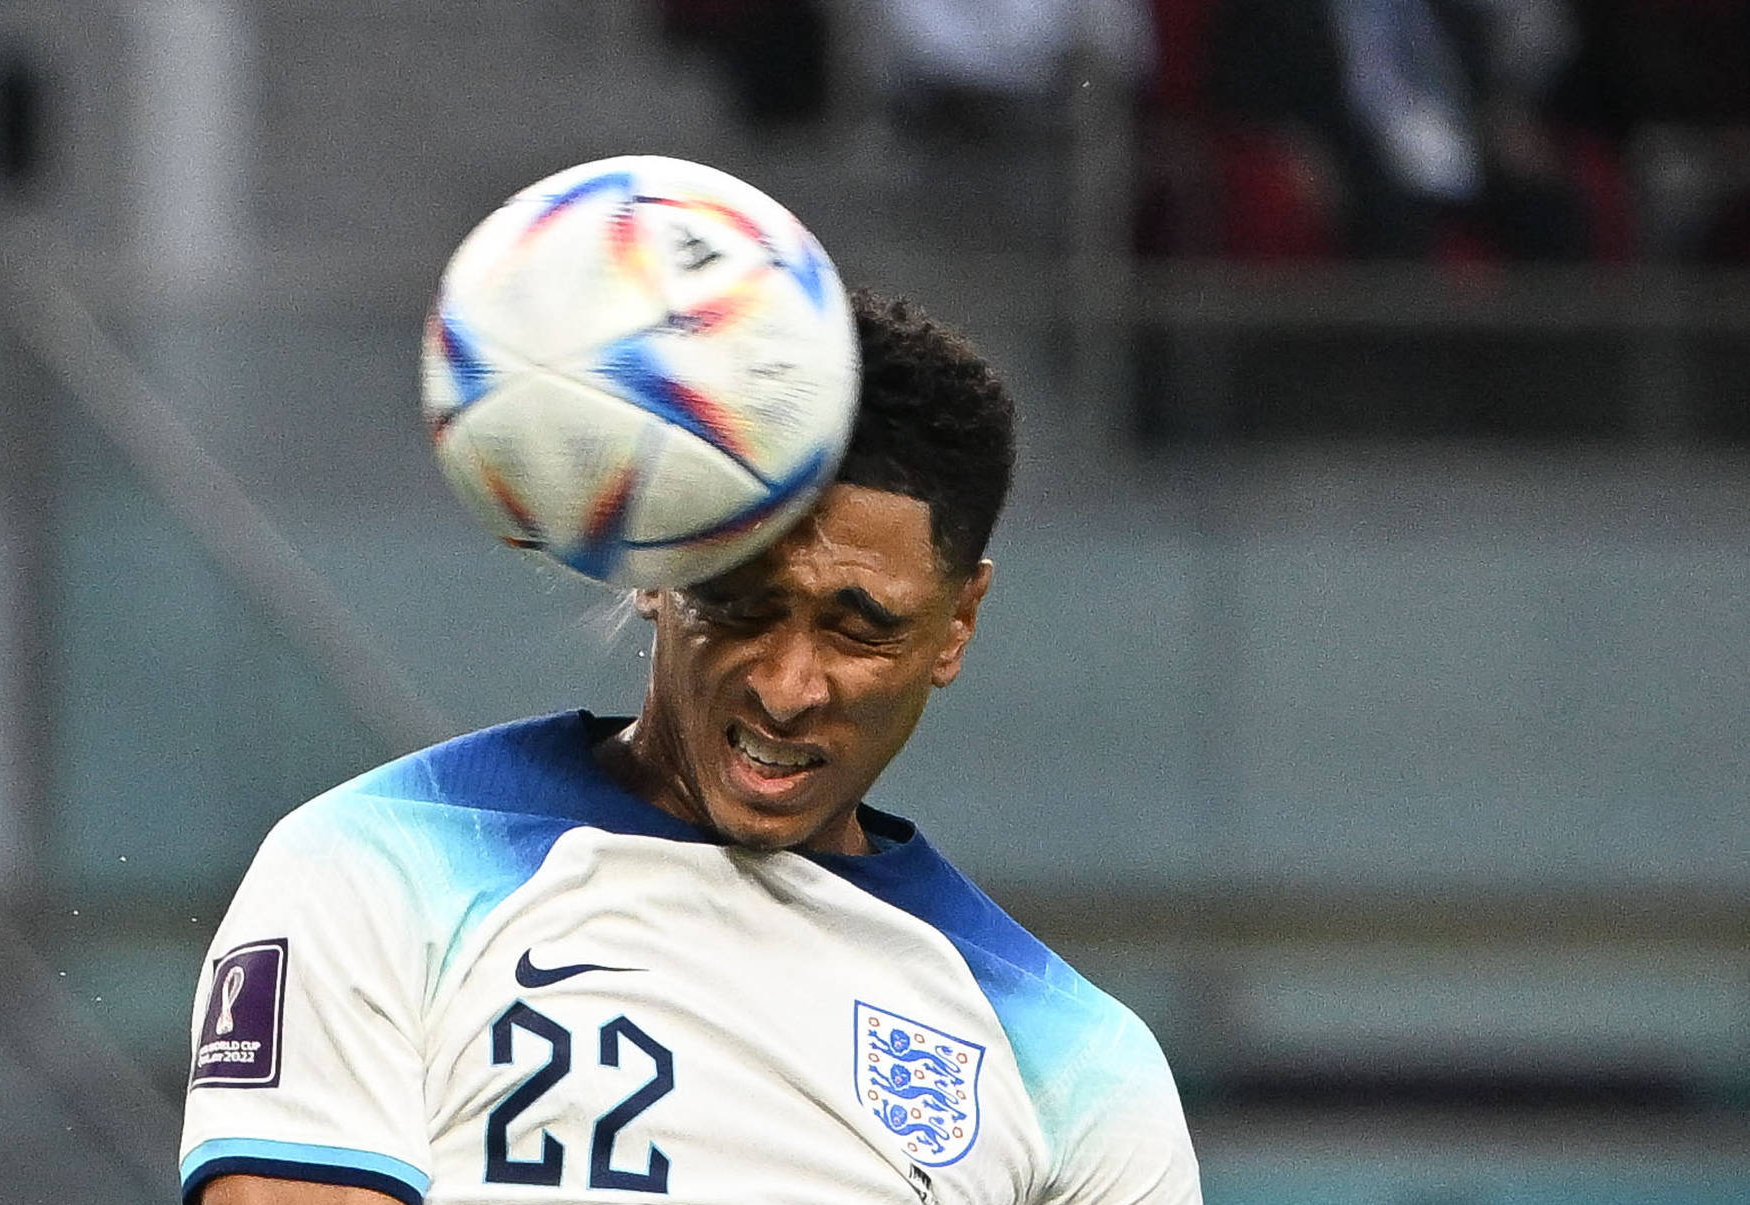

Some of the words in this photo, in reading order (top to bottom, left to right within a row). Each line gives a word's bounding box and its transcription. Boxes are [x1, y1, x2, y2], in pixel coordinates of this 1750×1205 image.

[240, 1040, 262, 1051] CUP
[223, 1051, 255, 1063] 2022
[484, 997, 675, 1194] 22
